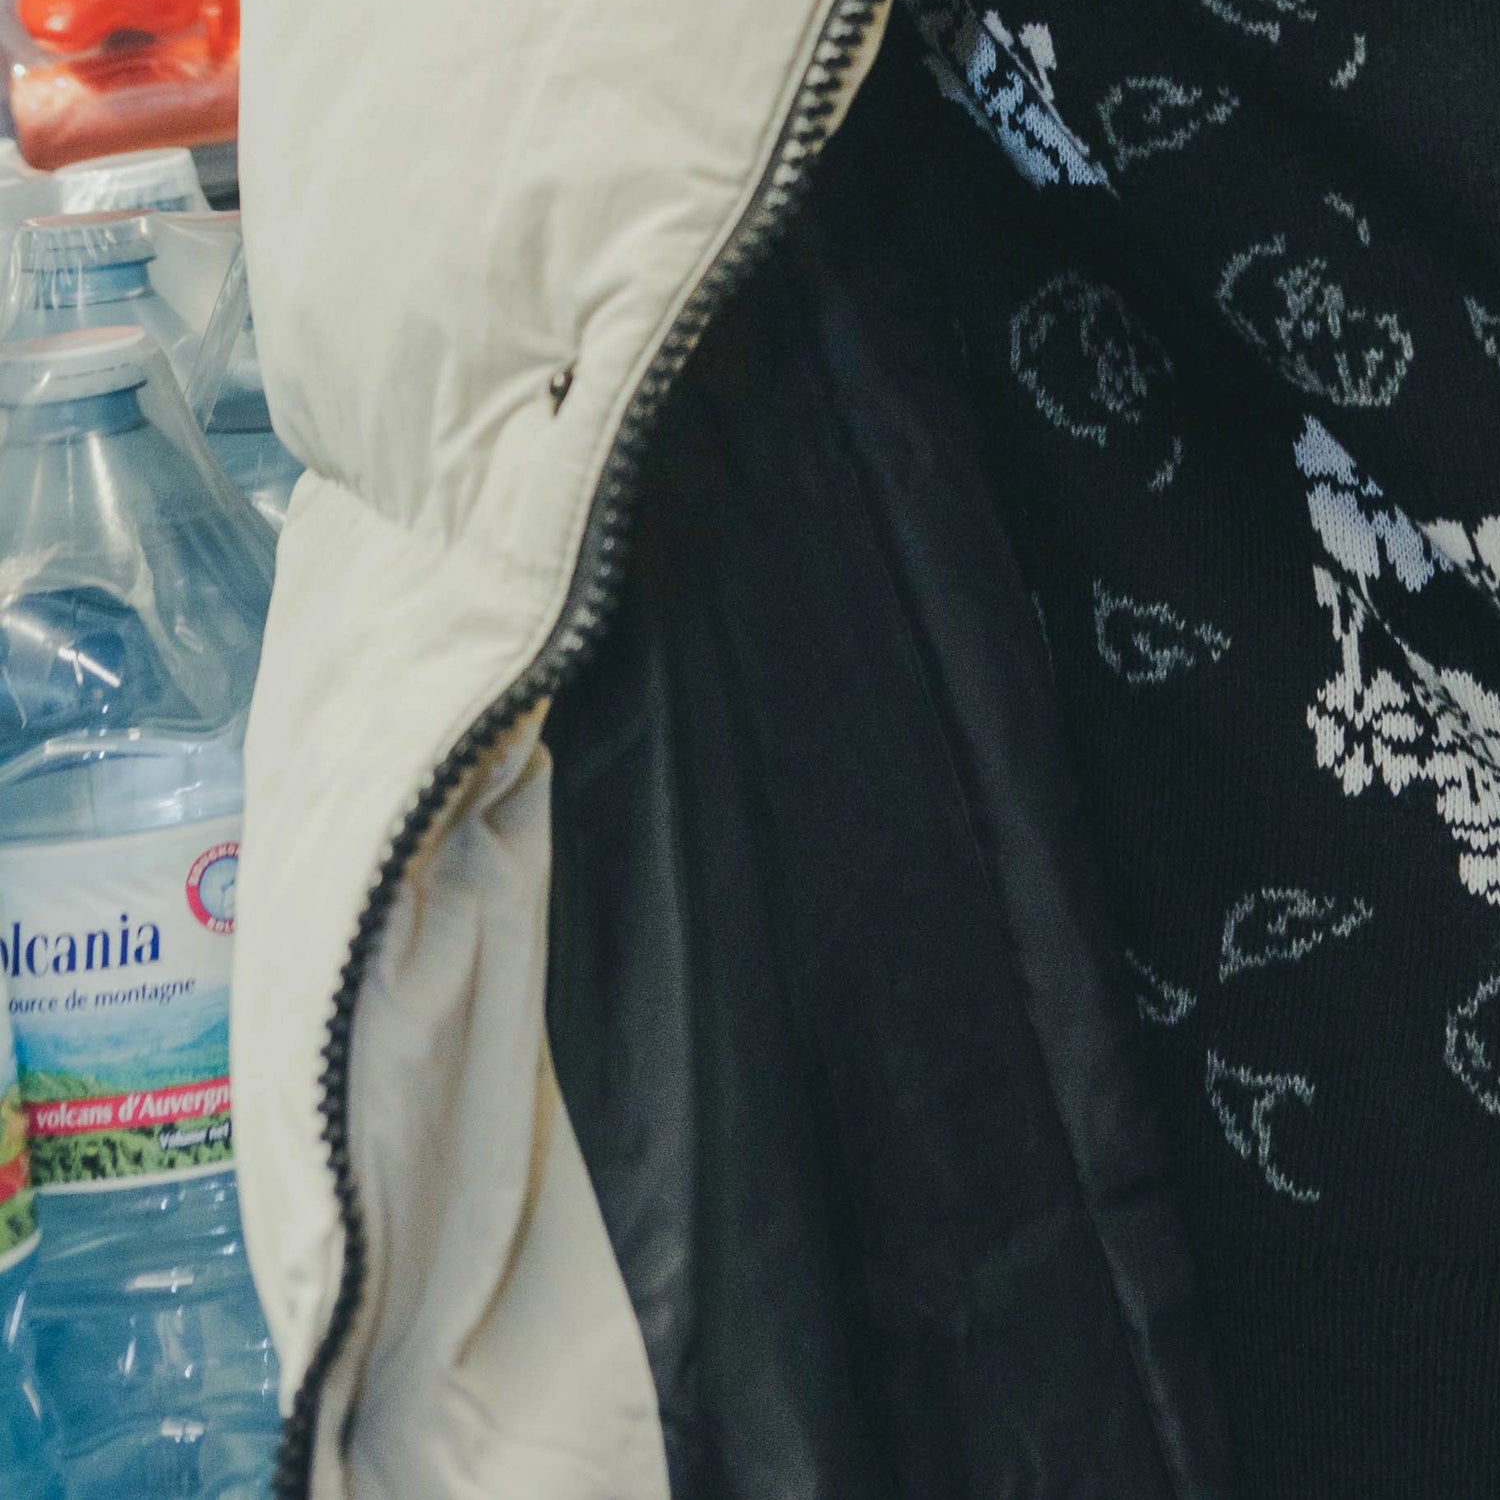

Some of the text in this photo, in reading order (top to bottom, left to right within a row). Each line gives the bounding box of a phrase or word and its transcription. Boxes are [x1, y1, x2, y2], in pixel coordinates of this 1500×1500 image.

[65, 989, 88, 1012] de
[95, 977, 196, 1006] montagne
[36, 1103, 113, 1129] volcans
